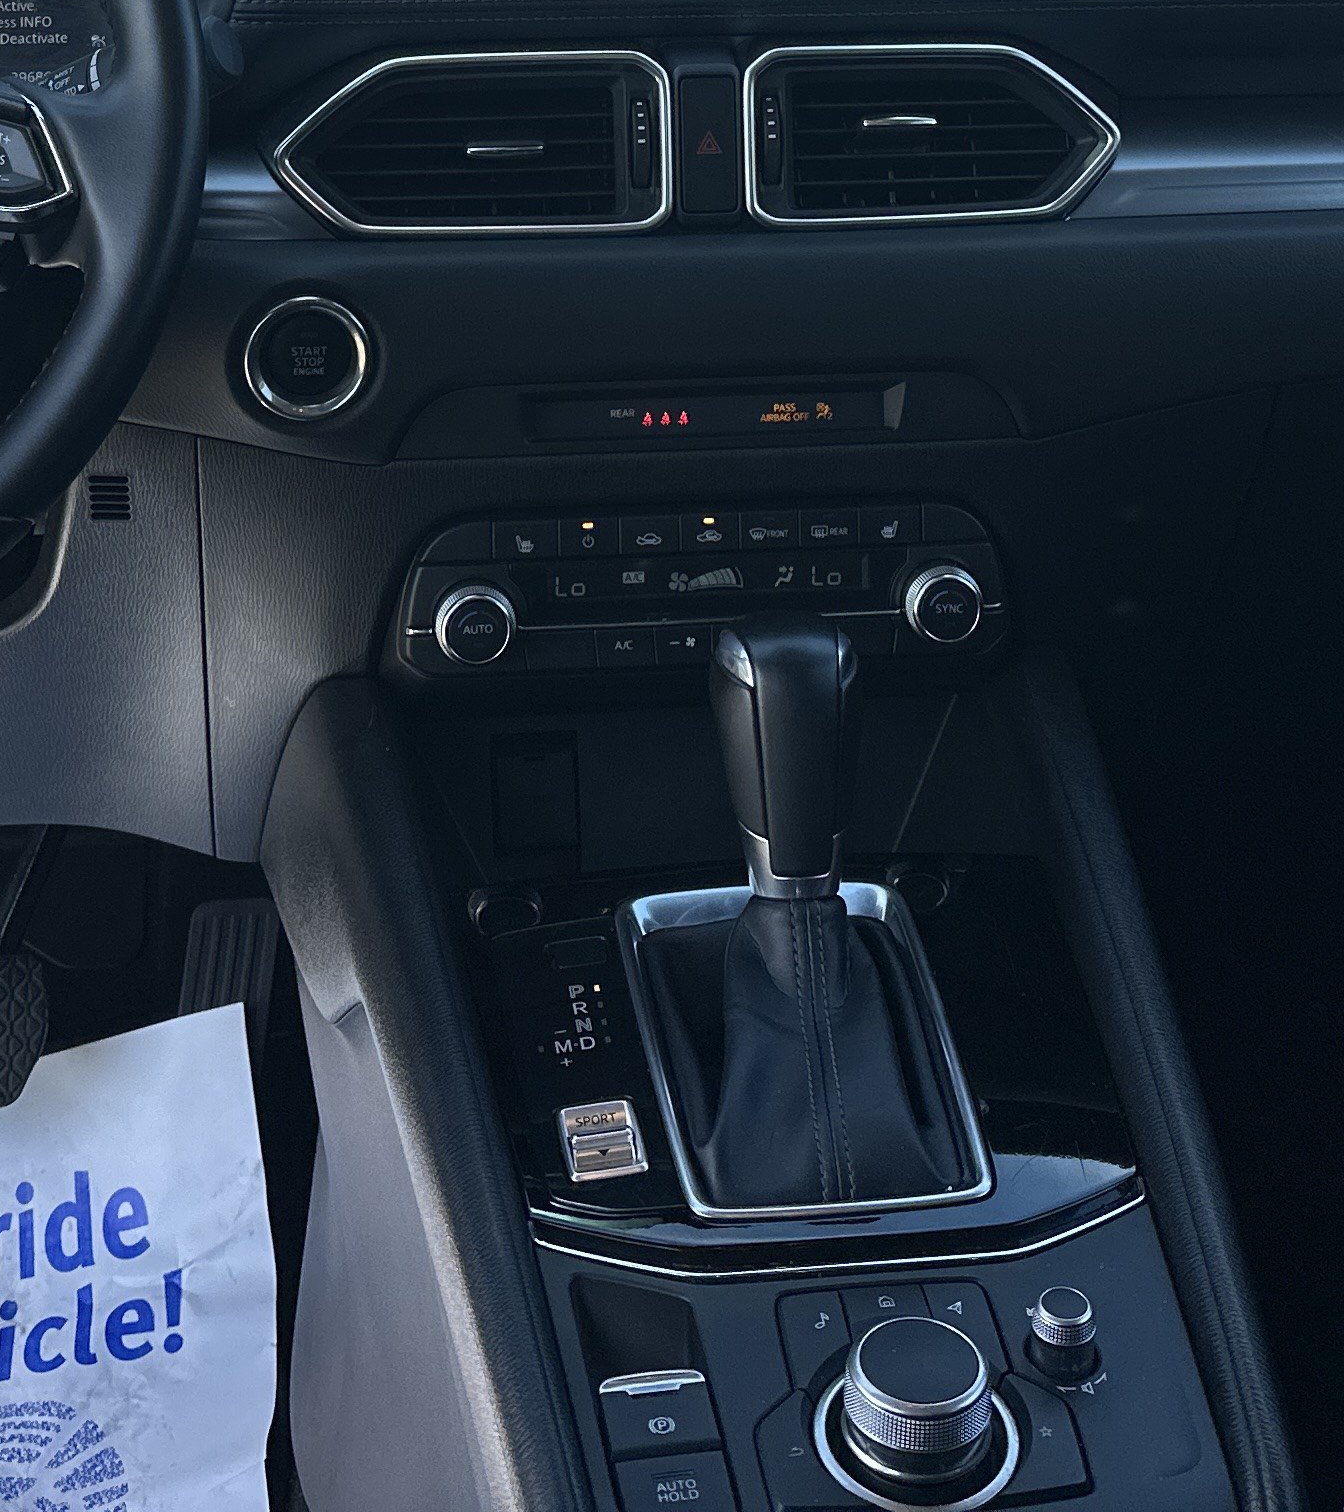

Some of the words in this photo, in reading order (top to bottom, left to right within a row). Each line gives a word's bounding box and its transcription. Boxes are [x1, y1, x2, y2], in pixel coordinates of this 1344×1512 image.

[20, 16, 52, 28] INFO
[0, 33, 68, 45] Deactivate
[54, 77, 71, 90] OFF
[291, 346, 327, 356] START
[295, 356, 324, 367] STOP
[293, 367, 325, 376] ENGINE
[610, 409, 635, 418] REAR
[773, 403, 797, 412] PASS
[760, 413, 791, 423] AIRBAG
[793, 412, 810, 422] OFF
[766, 529, 789, 538] FRONT
[829, 527, 848, 536] REAR
[622, 571, 645, 584] A/C
[935, 603, 964, 614] SYNC
[462, 624, 494, 636] AUTO
[614, 639, 634, 651] A/C
[568, 984, 585, 999] P
[572, 1001, 588, 1015] R
[575, 1017, 593, 1033] N
[575, 1112, 617, 1128] SPORT
[656, 1478, 697, 1492] AUTO
[657, 1489, 699, 1502] HOLD
